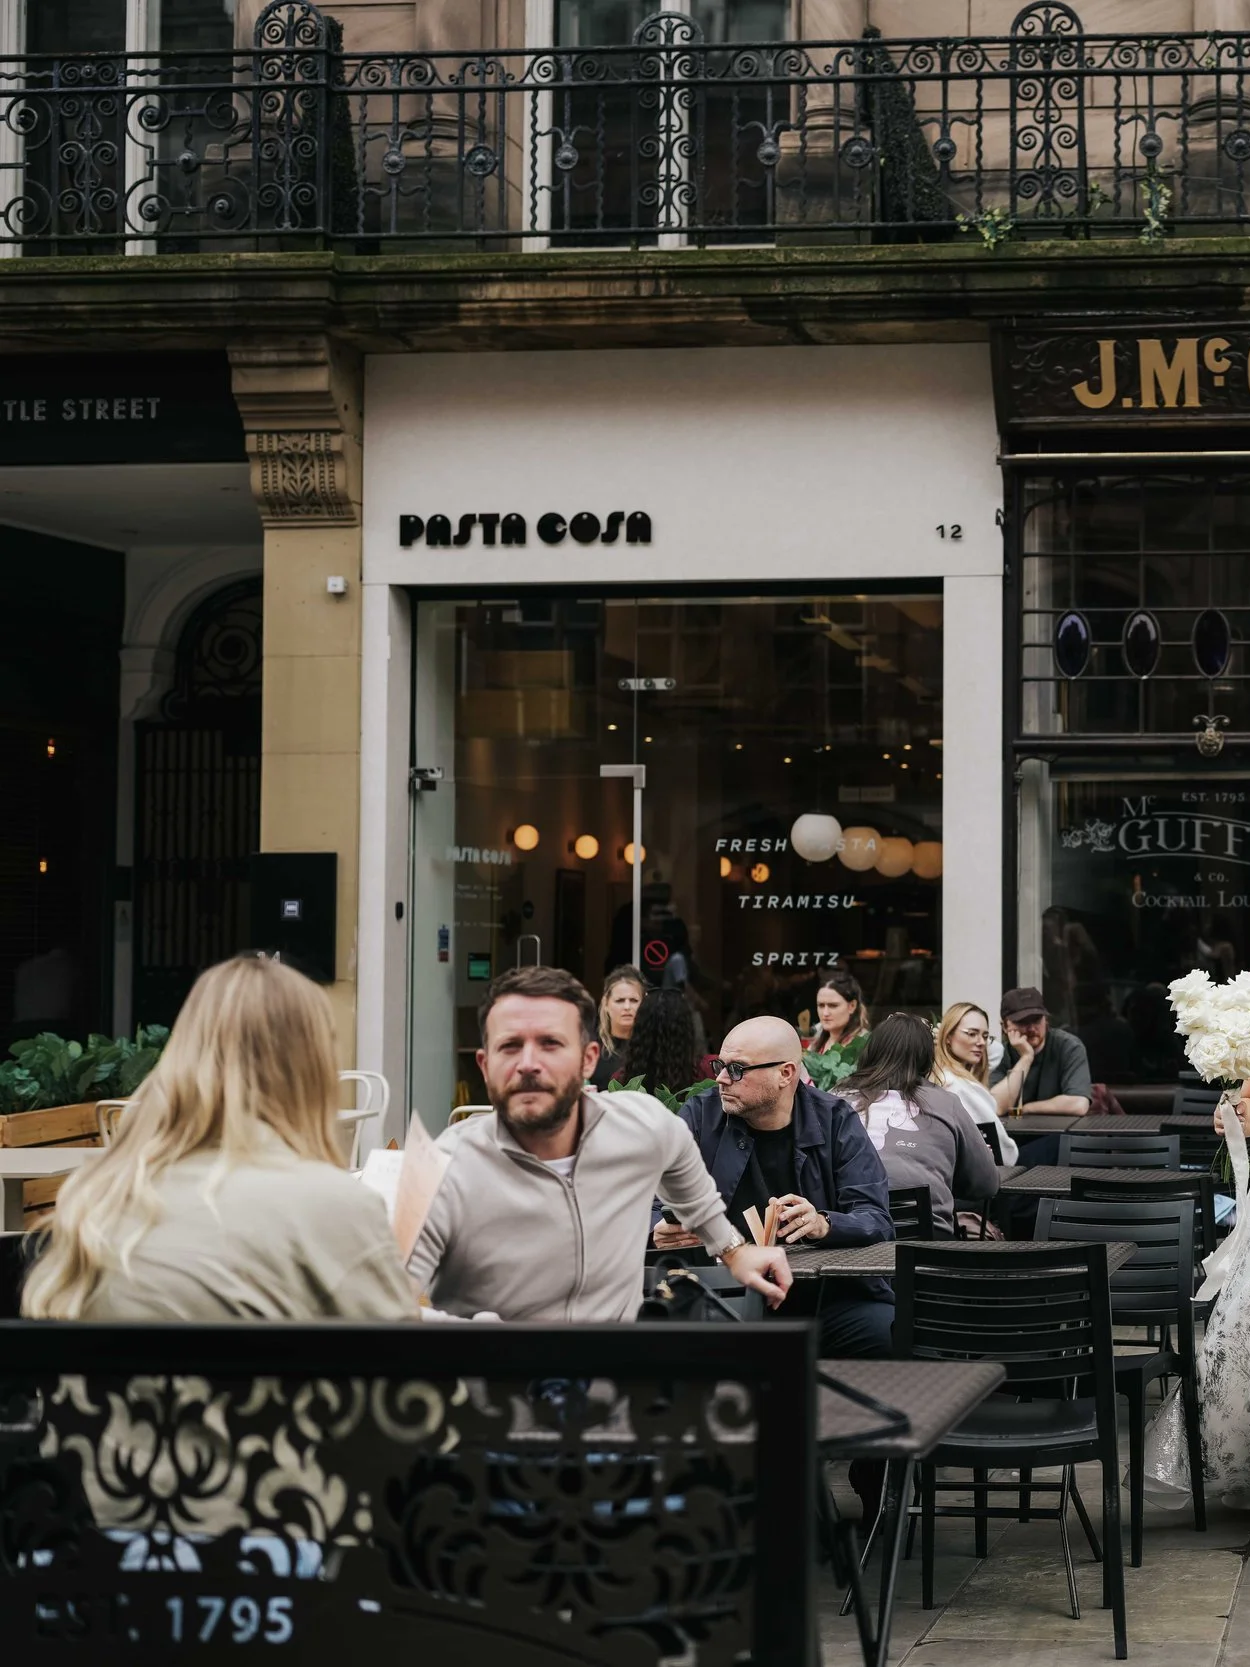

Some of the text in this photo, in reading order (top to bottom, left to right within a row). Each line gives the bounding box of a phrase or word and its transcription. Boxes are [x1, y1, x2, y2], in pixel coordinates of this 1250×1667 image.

[0, 397, 161, 421] TLE STREET
[400, 511, 652, 547] PASTA COSA
[935, 524, 962, 539] 12
[1181, 792, 1246, 803] EST. 1795
[715, 838, 877, 852] FRESH STA
[738, 896, 855, 909] TIRAMISU
[752, 952, 840, 966] SPRITZ
[166, 1596, 293, 1644] 1795
